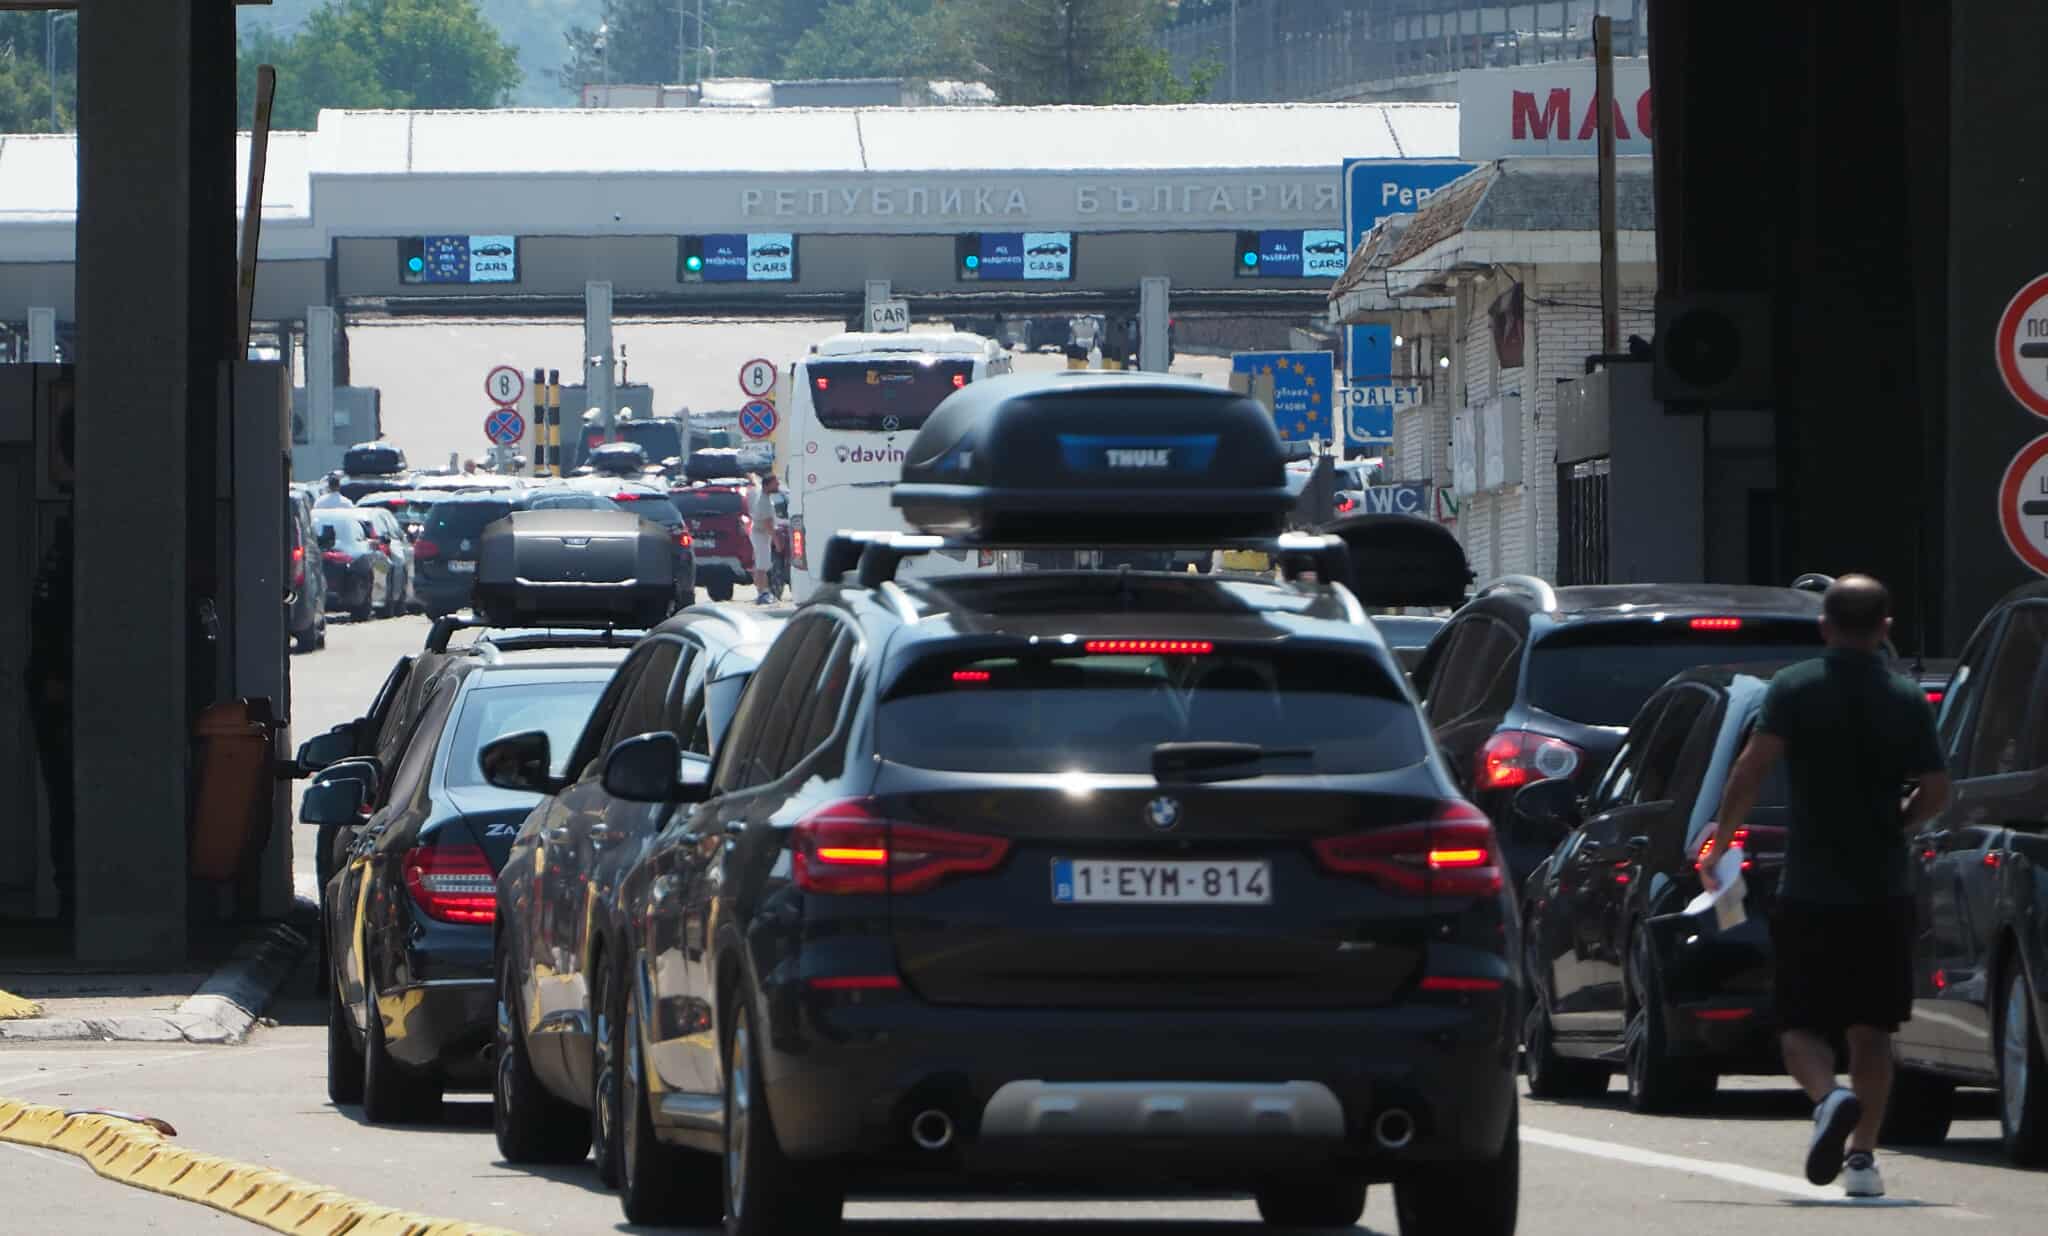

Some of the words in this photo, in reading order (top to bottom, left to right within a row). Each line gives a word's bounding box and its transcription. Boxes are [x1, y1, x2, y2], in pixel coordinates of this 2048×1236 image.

[741, 187, 1029, 216] РЕПУБЛИКА
[1075, 183, 1339, 214] БЪЛГАРИЯ
[475, 262, 508, 272] CARS
[752, 262, 787, 273] CARS
[1030, 261, 1064, 272] CARS
[1310, 259, 1344, 268] CARS
[873, 307, 905, 322] CAR
[500, 375, 510, 396] 8
[753, 366, 763, 387] 8
[1338, 387, 1418, 404] TOALET
[850, 444, 908, 463] davin
[1106, 449, 1169, 468] THULE
[1369, 487, 1417, 514] WC
